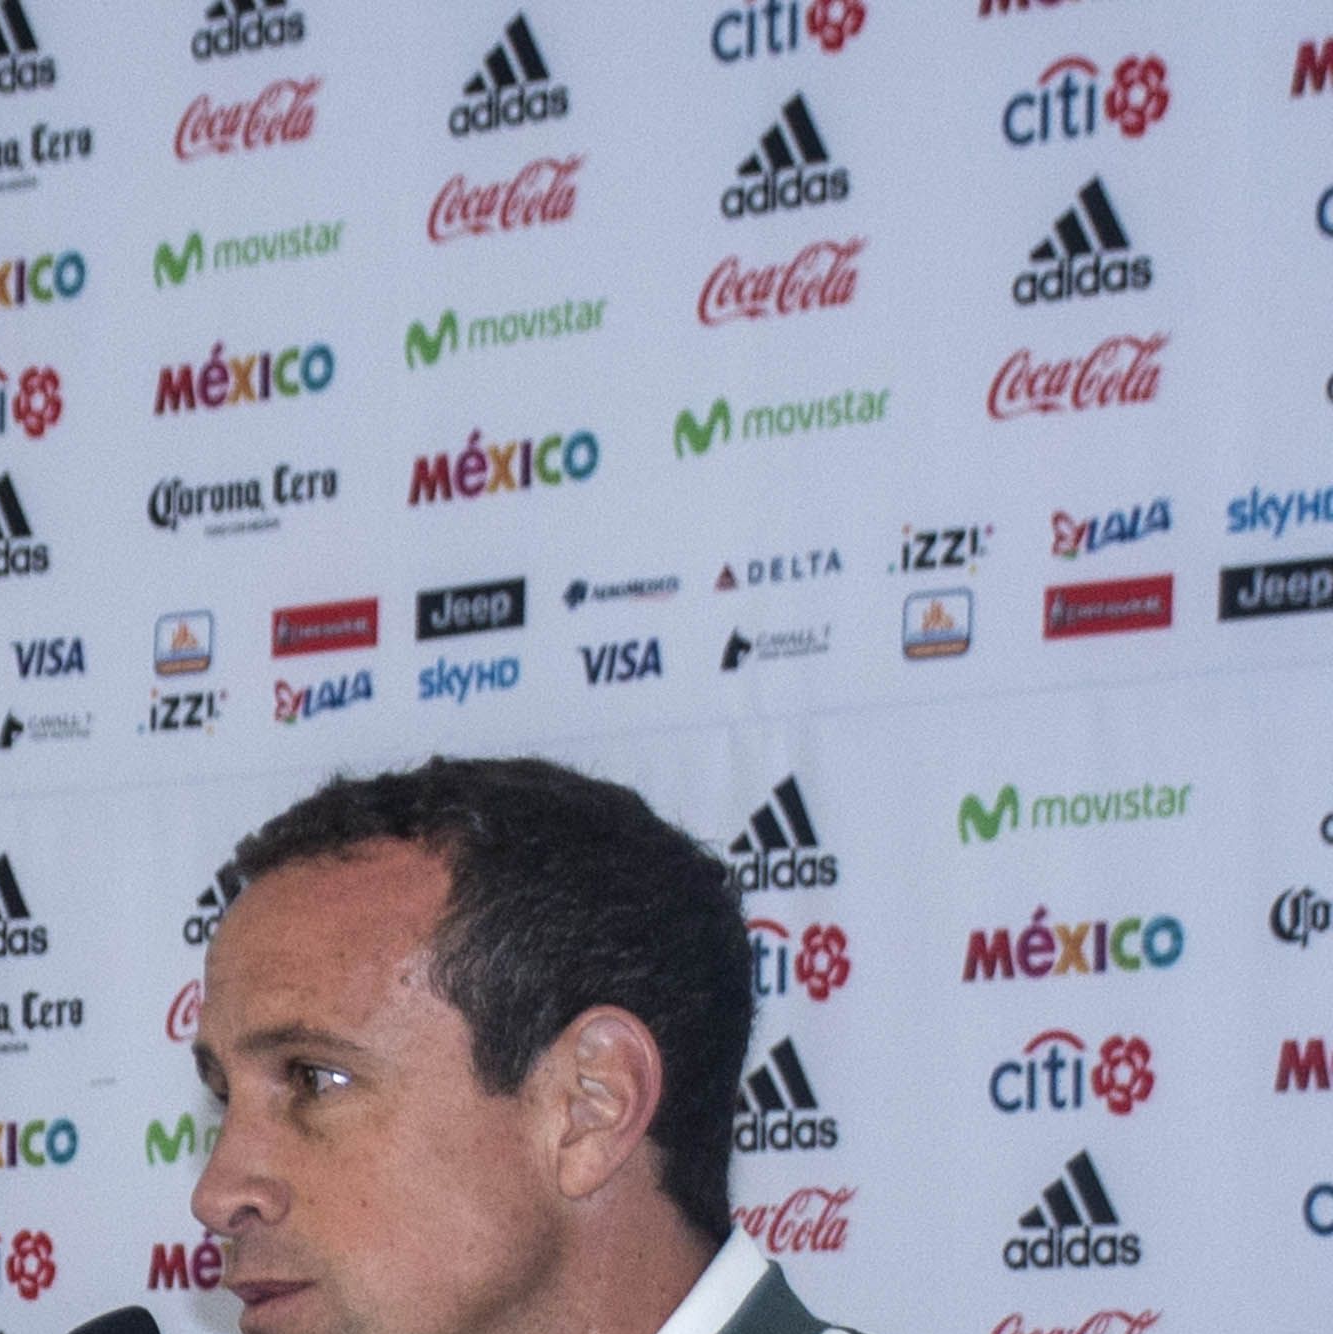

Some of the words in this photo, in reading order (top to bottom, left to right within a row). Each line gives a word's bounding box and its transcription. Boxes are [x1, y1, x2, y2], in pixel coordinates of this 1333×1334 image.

[191, 14, 306, 61] adidas
[711, 0, 799, 64] citi
[448, 85, 569, 138] adidas
[1002, 84, 1097, 147] citi
[31, 123, 92, 163] Cero
[720, 167, 850, 220] adidas
[213, 221, 344, 269] movistar
[1012, 257, 1153, 306] adidas
[467, 299, 607, 349] movistar
[742, 389, 890, 439] movistar
[147, 478, 262, 534] Corona
[273, 464, 338, 506] Cero
[747, 548, 843, 586] DELTA
[431, 591, 512, 629] Jeep
[13, 638, 85, 679] VISA
[580, 638, 662, 685] VISA
[1030, 783, 1192, 828] movistar
[22, 991, 84, 1031] Cero
[989, 1045, 1083, 1114] citi
[734, 1108, 839, 1153] didas
[1003, 1228, 1142, 1271] adidas
